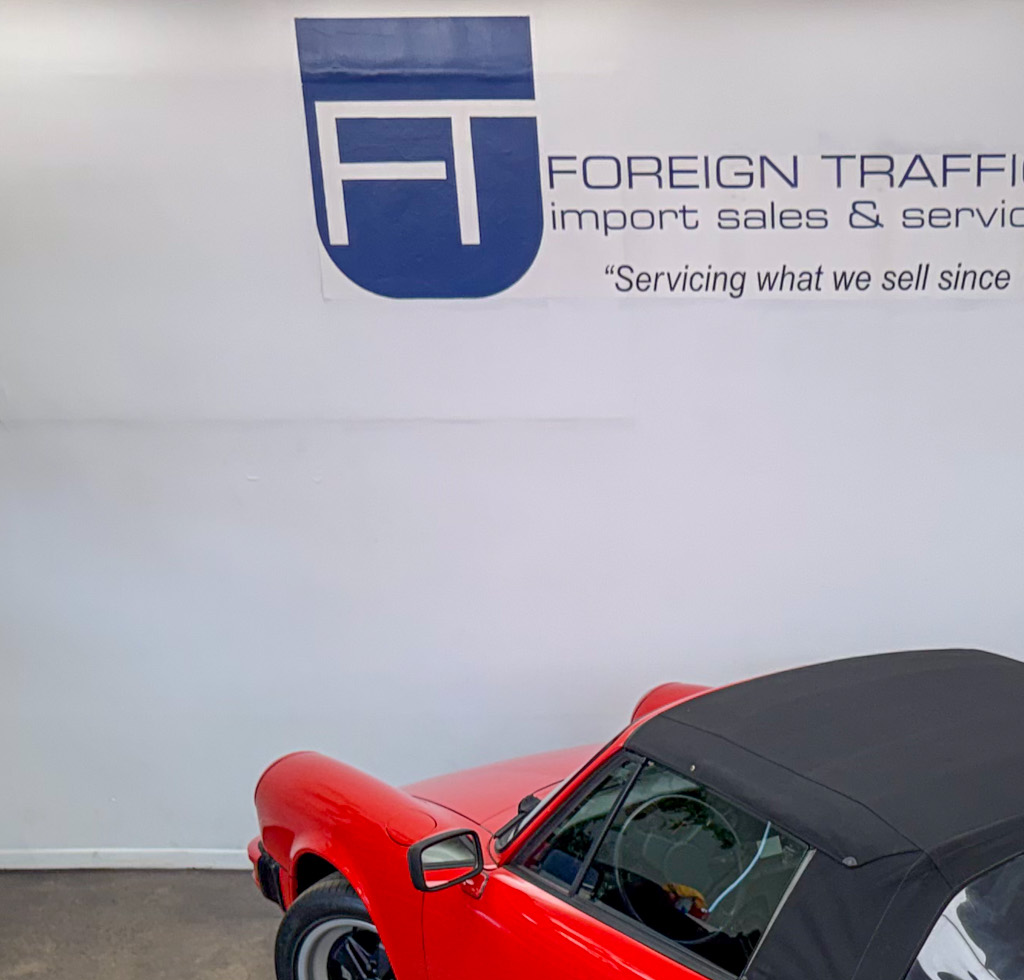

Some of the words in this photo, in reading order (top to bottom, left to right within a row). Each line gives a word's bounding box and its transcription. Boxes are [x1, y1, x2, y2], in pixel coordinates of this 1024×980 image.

[547, 154, 799, 190] FOREIGN
[551, 201, 700, 237] import
[717, 200, 829, 230] sales
[848, 200, 885, 230] &
[756, 264, 824, 292] what
[832, 270, 872, 292] we
[881, 263, 931, 292] sell
[937, 262, 1011, 291] since
